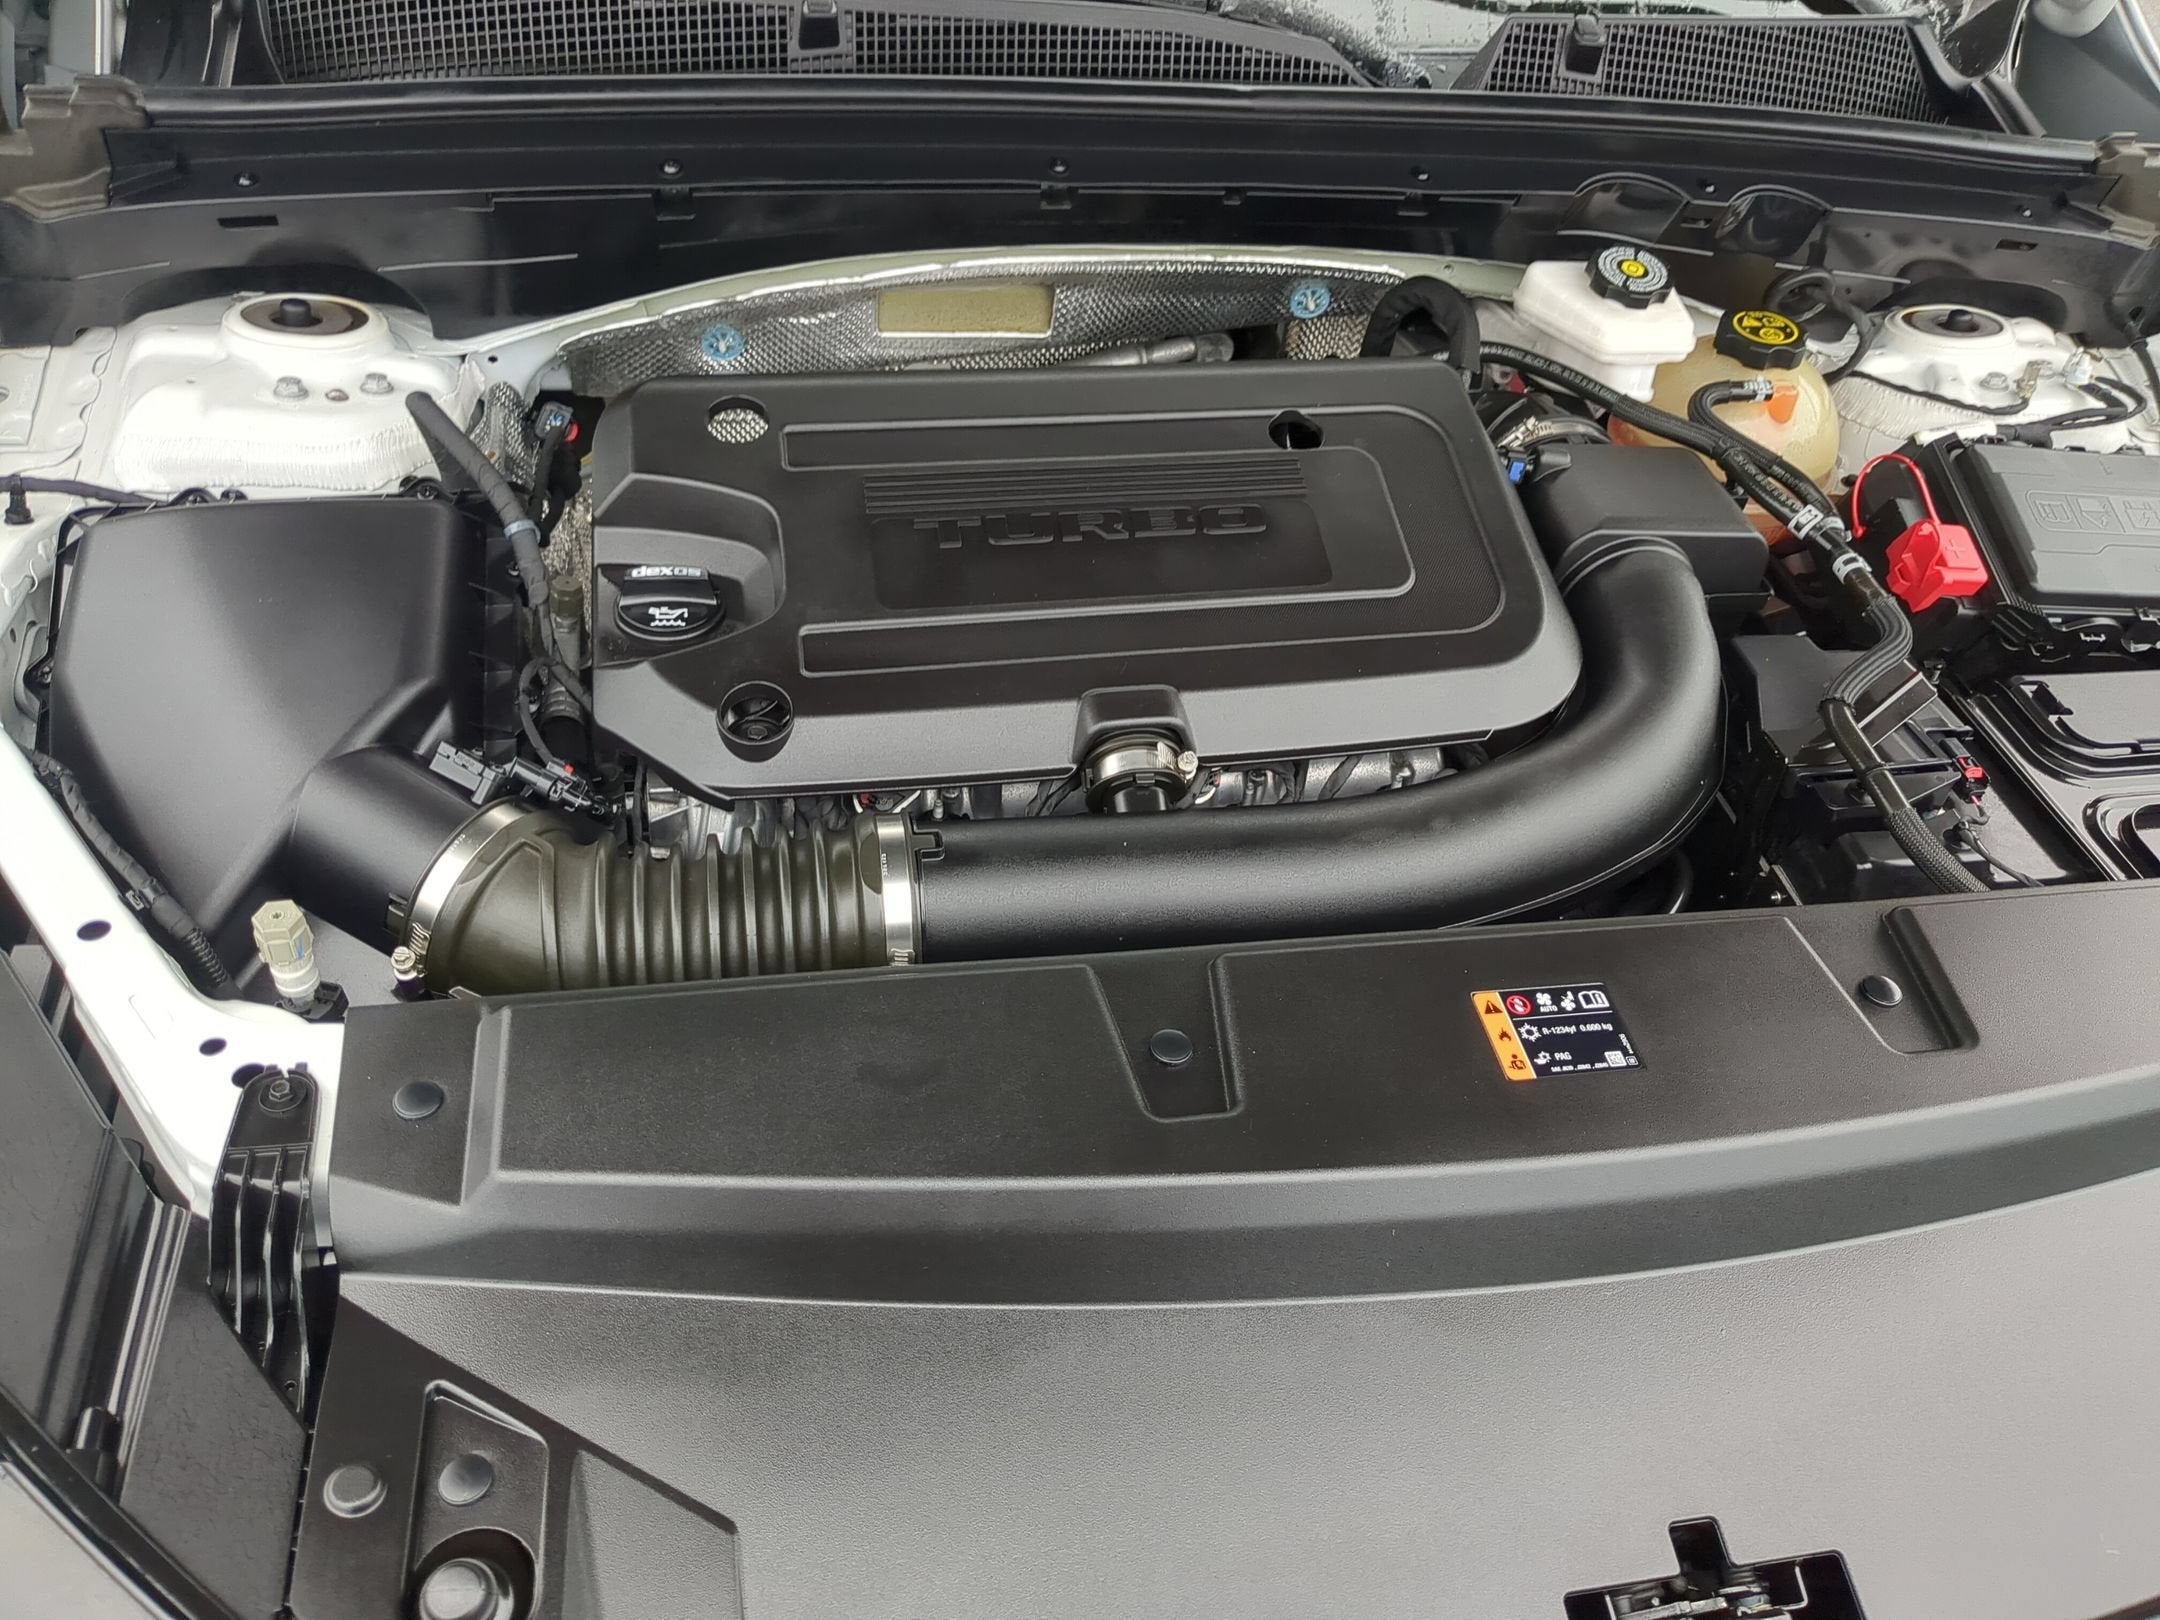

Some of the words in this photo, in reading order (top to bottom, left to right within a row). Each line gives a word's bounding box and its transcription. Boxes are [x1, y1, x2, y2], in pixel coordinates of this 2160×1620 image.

[913, 504, 1267, 548] TURBO
[631, 565, 701, 578] dexos
[1540, 1005, 1558, 1013] AUTO
[1601, 1022, 1613, 1031] kg
